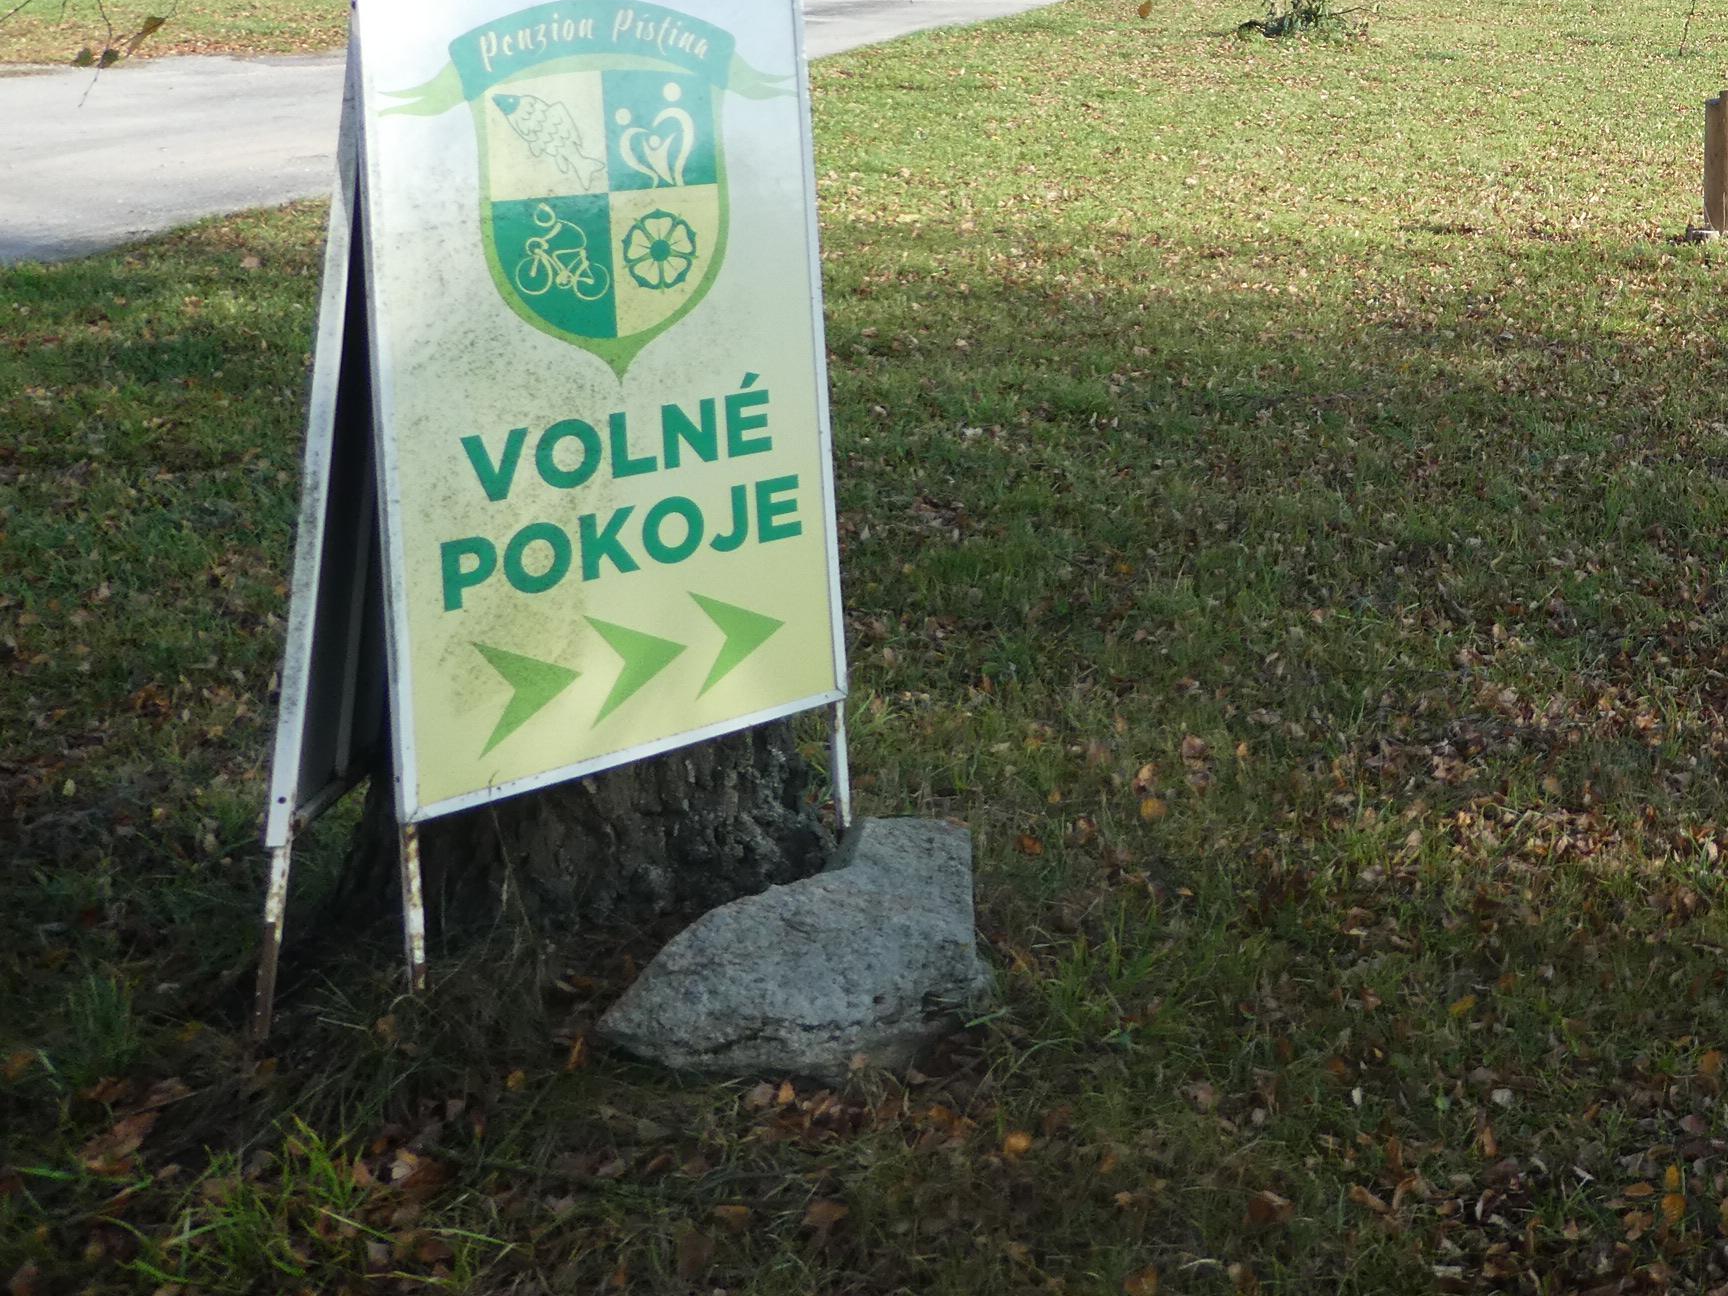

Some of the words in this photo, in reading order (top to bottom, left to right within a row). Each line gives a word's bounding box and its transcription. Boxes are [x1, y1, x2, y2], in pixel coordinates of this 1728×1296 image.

[479, 12, 594, 73] Penzion
[461, 372, 772, 502] VOLNÉ
[441, 474, 803, 612] POKOJE
